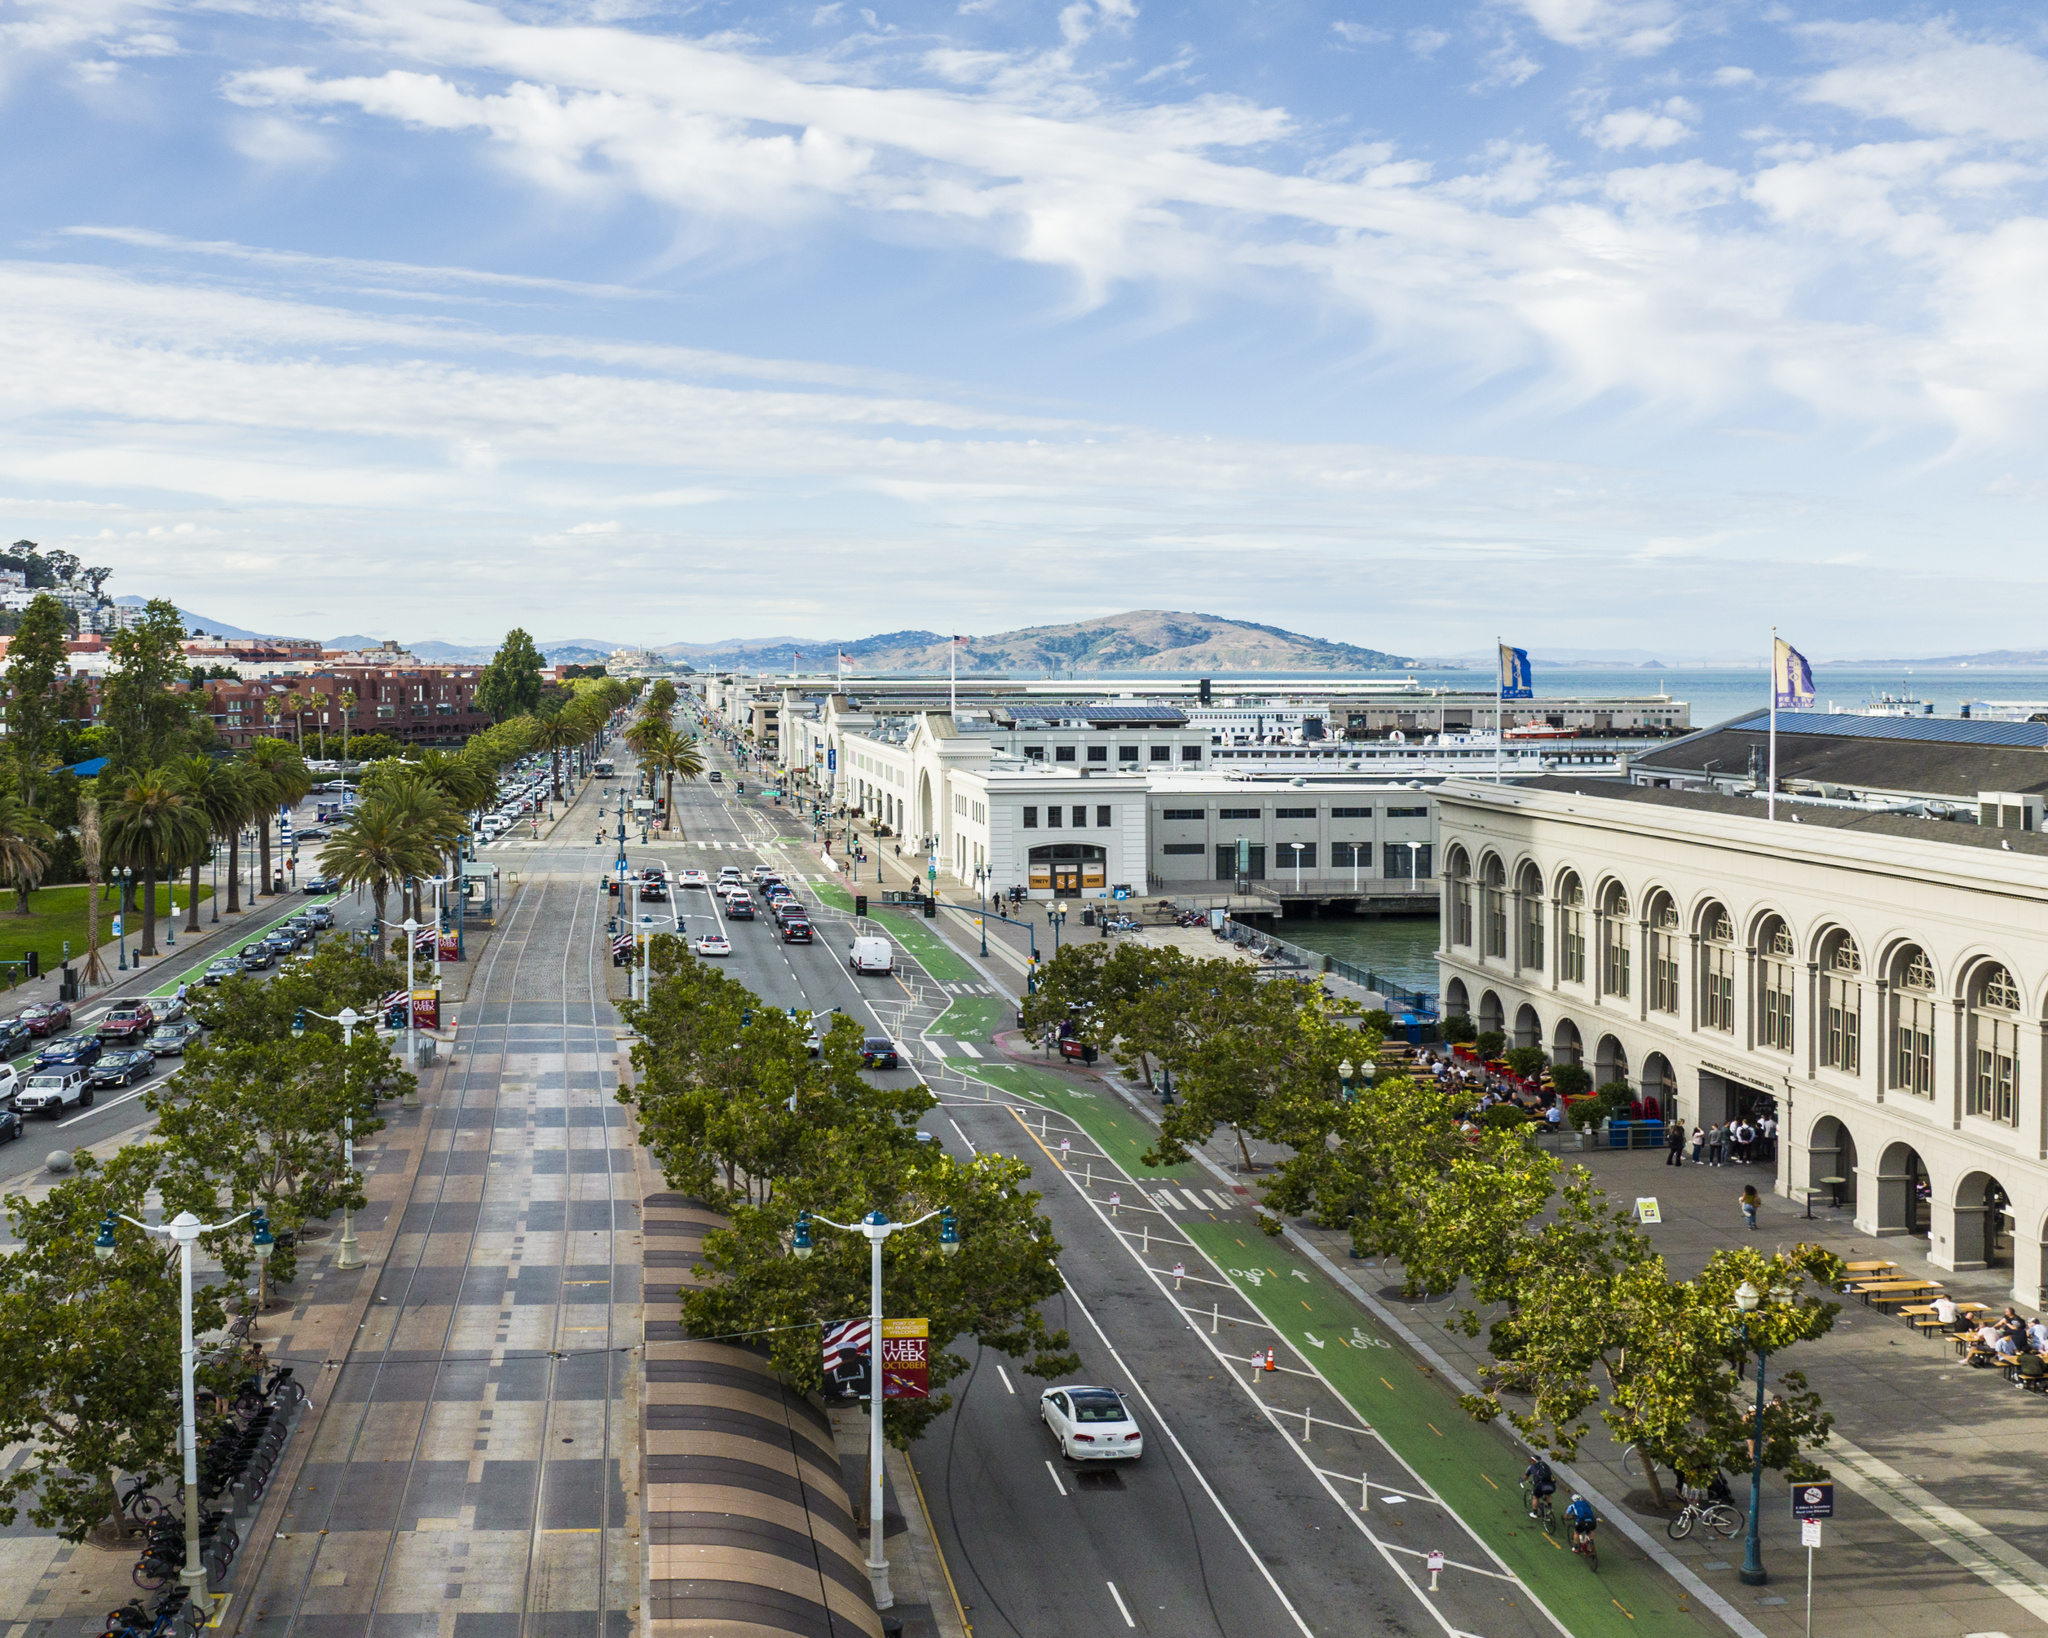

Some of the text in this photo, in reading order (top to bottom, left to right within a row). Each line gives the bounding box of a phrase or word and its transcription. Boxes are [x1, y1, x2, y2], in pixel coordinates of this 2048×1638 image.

[882, 1340, 926, 1351] FLEET
[883, 1350, 926, 1361] WEEK
[882, 1361, 927, 1370] OCTOBER
